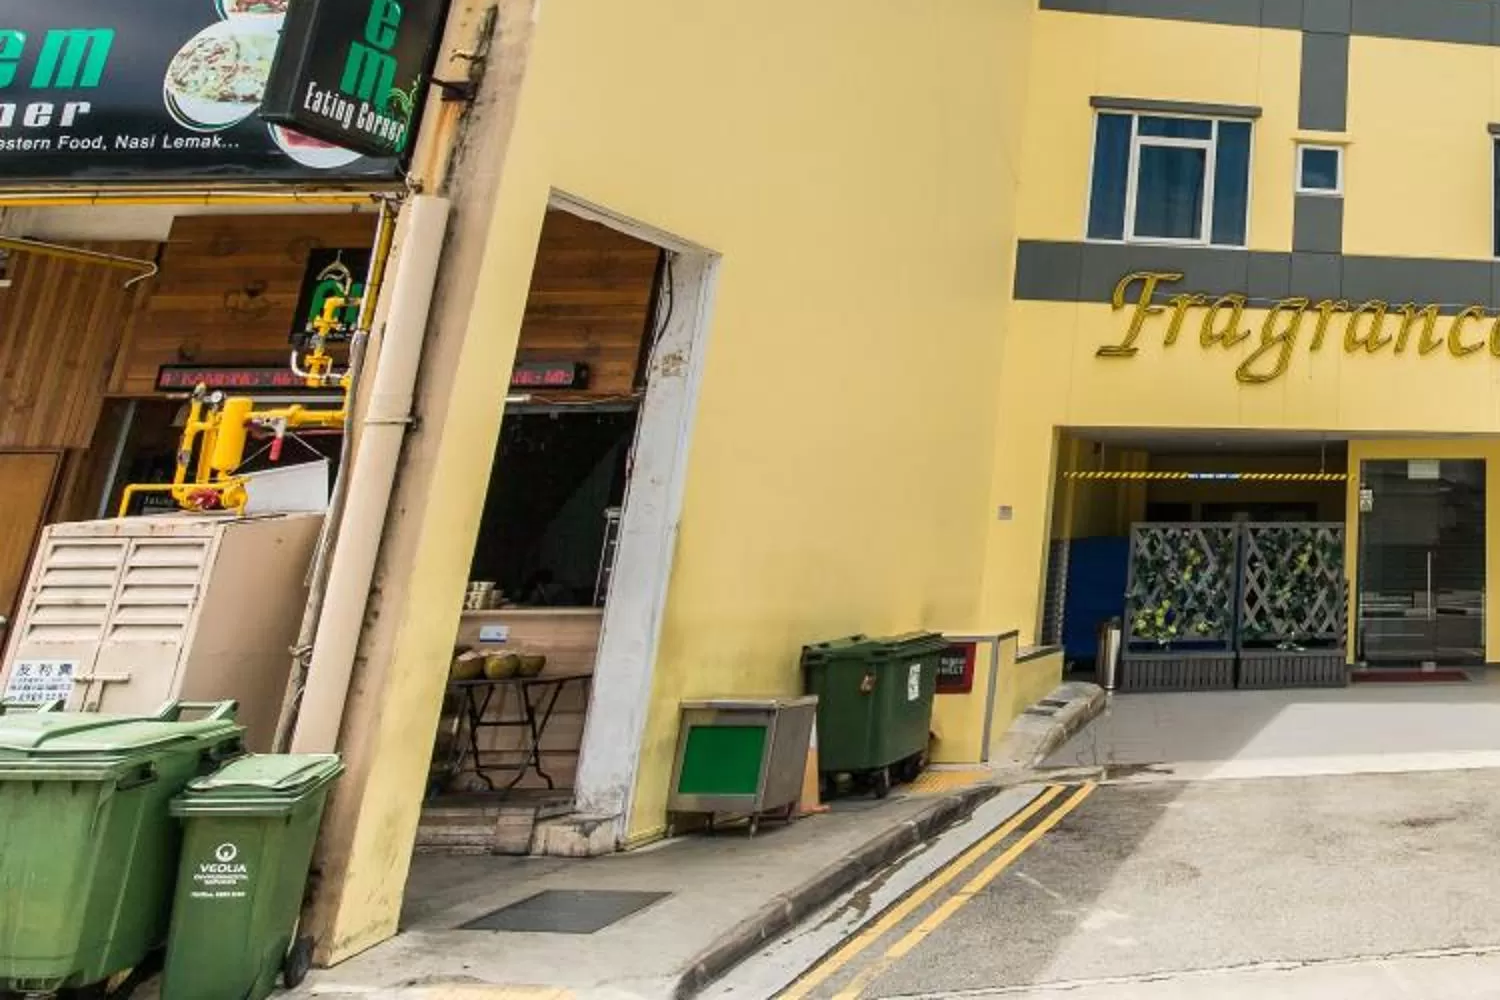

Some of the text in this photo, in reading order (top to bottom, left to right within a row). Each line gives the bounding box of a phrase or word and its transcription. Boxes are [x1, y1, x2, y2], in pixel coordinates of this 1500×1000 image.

[304, 81, 405, 142] Eating Corner
[57, 134, 107, 151] Food,
[115, 134, 157, 150] Nasi
[200, 863, 247, 873] VEOLIA
